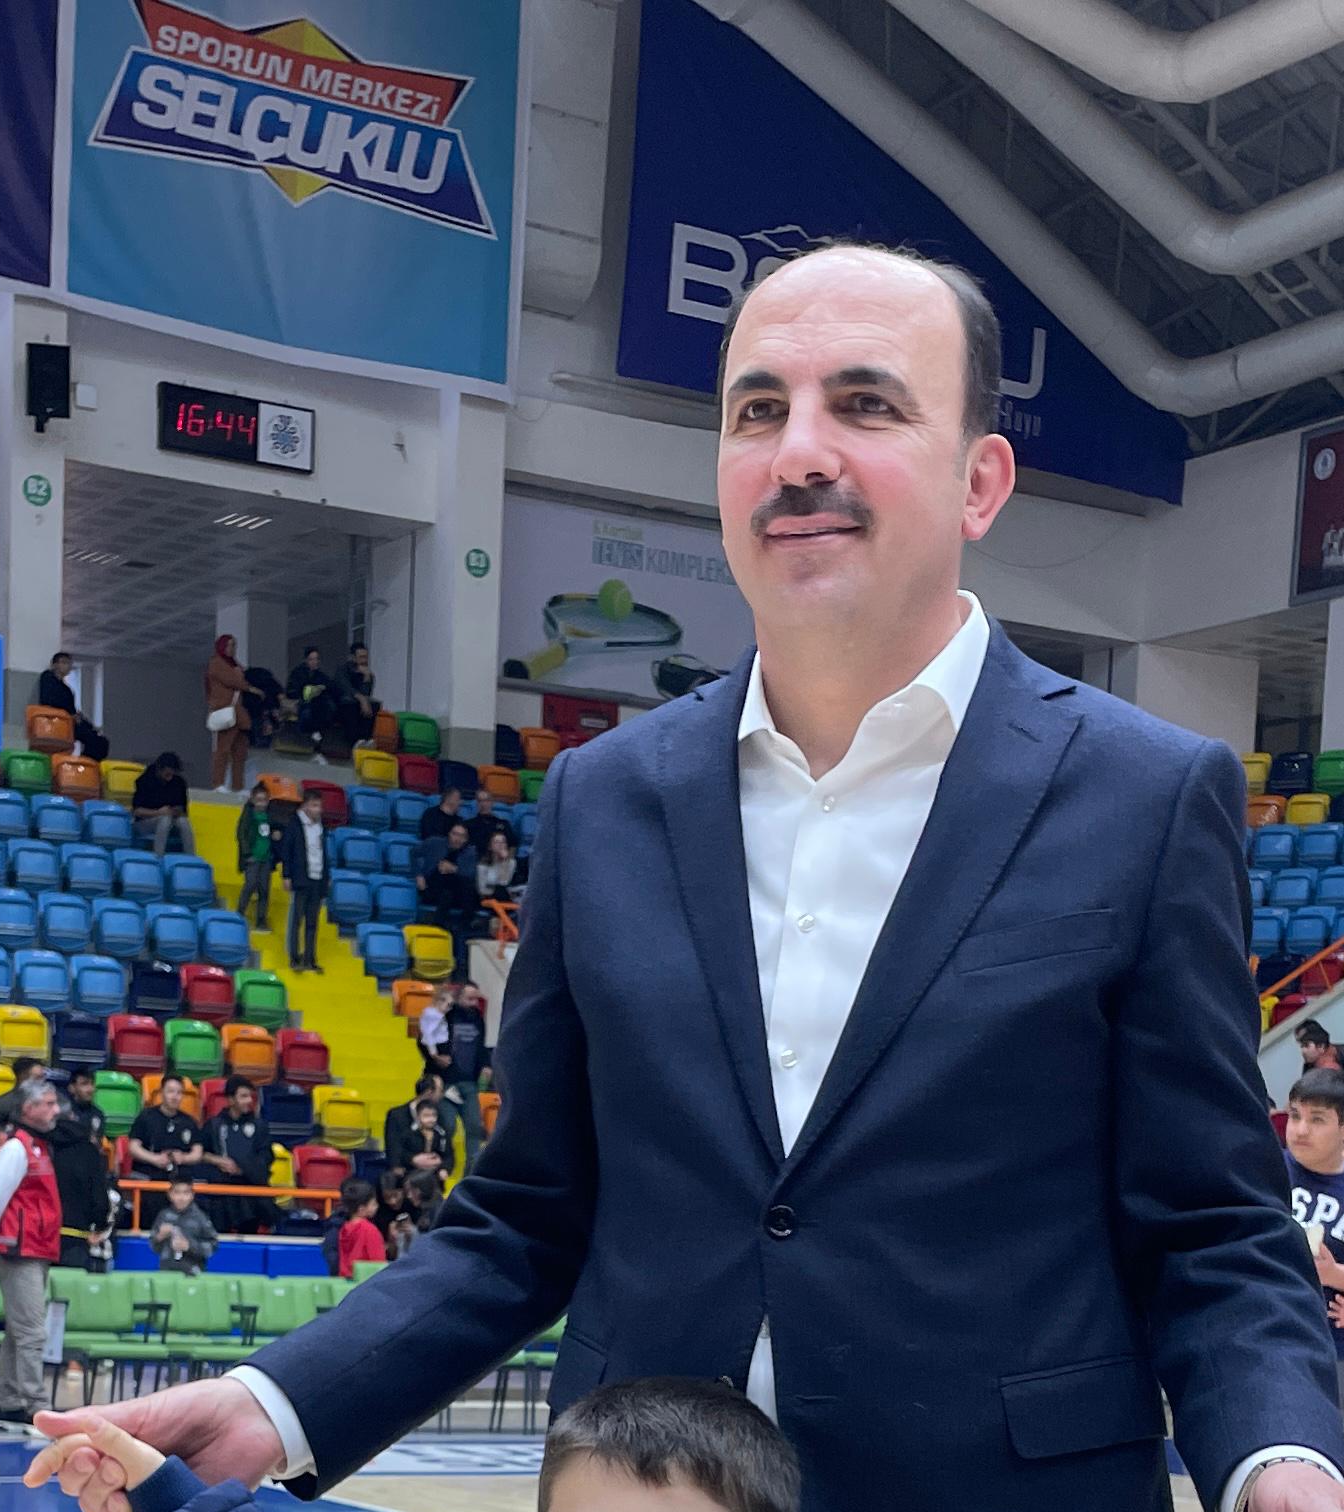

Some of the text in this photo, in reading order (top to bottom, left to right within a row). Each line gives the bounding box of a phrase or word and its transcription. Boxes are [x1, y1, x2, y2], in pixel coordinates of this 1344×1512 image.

[132, 64, 453, 194] SELÇUKLU
[156, 24, 442, 121] SPORUN MERKEZİ
